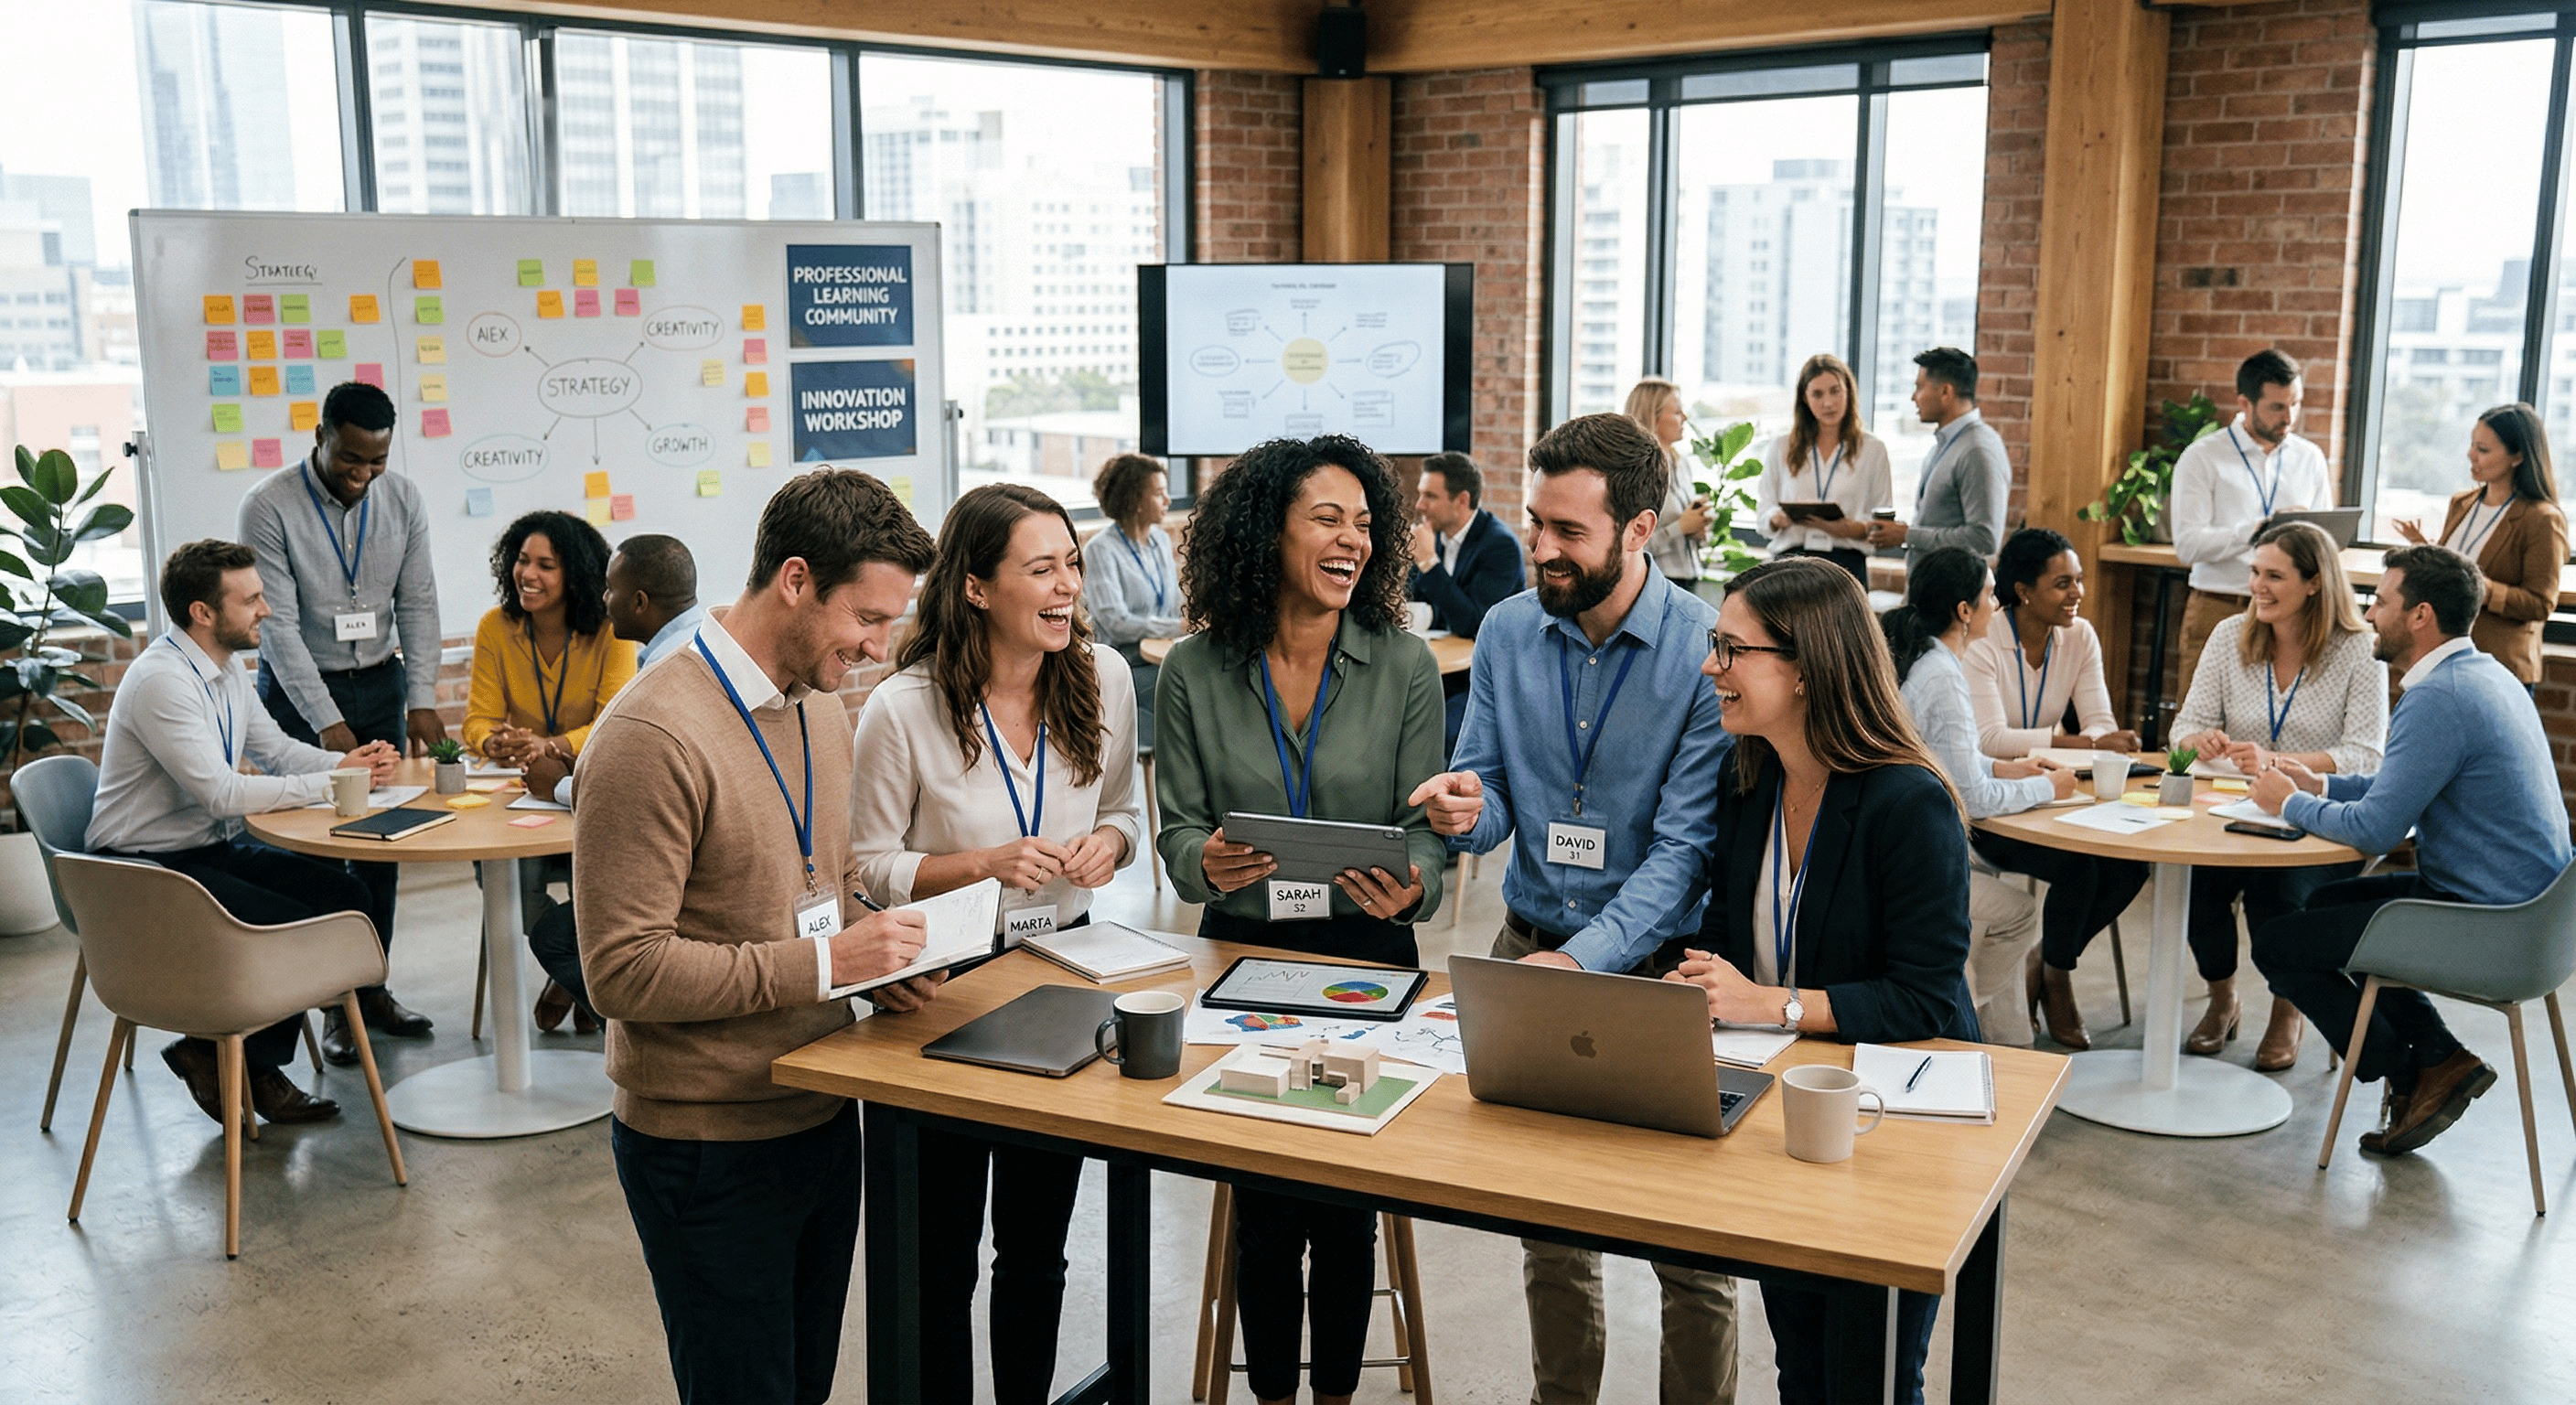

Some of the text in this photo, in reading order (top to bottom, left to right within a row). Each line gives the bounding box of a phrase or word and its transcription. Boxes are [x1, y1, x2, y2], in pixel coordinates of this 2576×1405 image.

[793, 266, 907, 284] PROFESSIONAL
[813, 286, 890, 304] LEARNING
[805, 307, 897, 325] COMMUNITY
[647, 321, 719, 338] CREATIVITY
[547, 376, 630, 397] STRATEGY
[801, 387, 906, 410] INNOVATION
[804, 409, 904, 432] WORKSHOP
[653, 436, 708, 455] GROWTH
[464, 448, 543, 468] CREATIVITY
[1556, 835, 1595, 851] DAVID
[1569, 851, 1581, 860] 31
[1276, 888, 1321, 901] SARAH
[809, 915, 832, 934] ALEX
[1010, 917, 1052, 932] MARTA
